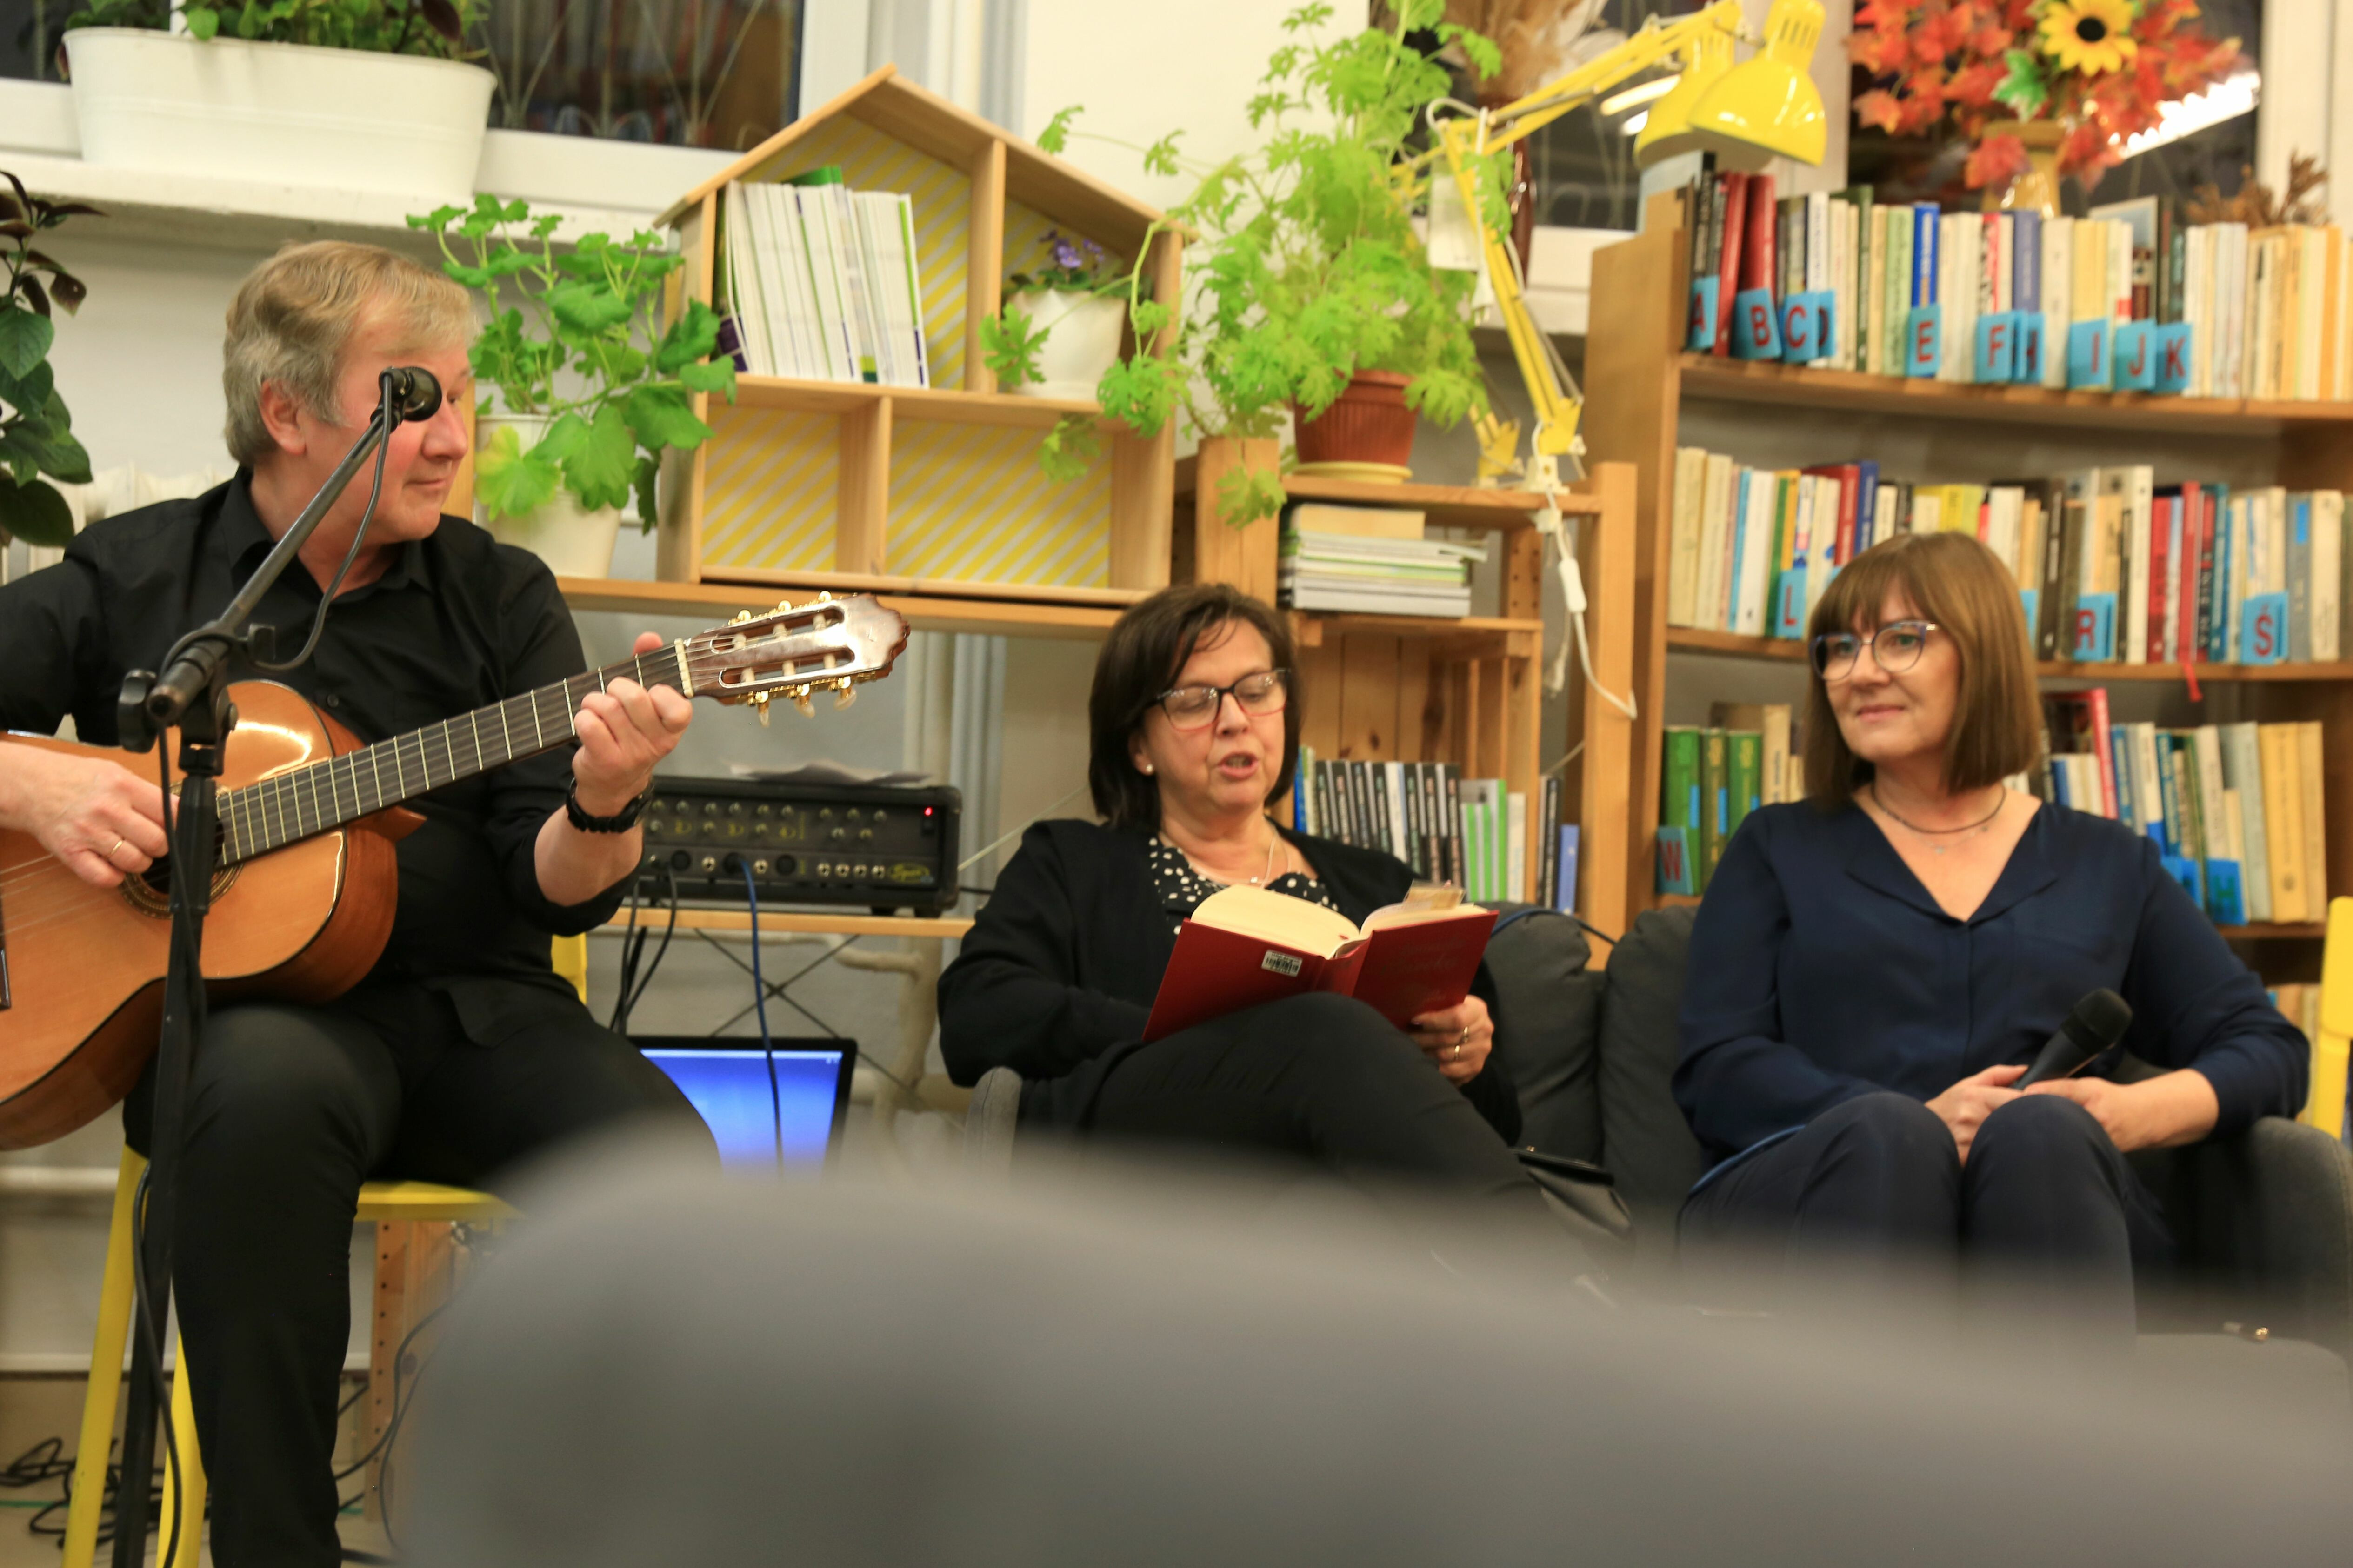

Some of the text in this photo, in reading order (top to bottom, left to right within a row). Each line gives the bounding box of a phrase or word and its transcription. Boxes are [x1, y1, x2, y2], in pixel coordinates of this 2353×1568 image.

[1689, 292, 1706, 333] A
[1751, 305, 1771, 347] B
[1785, 304, 1807, 350] C
[1917, 320, 1934, 364] E
[1988, 324, 2006, 368] F
[2091, 332, 2100, 374] I
[2128, 333, 2146, 377] J
[2166, 335, 2186, 379] K
[1784, 585, 1797, 627] L
[2076, 609, 2096, 650] R
[1657, 840, 1681, 881] W
[2213, 875, 2239, 917] H
